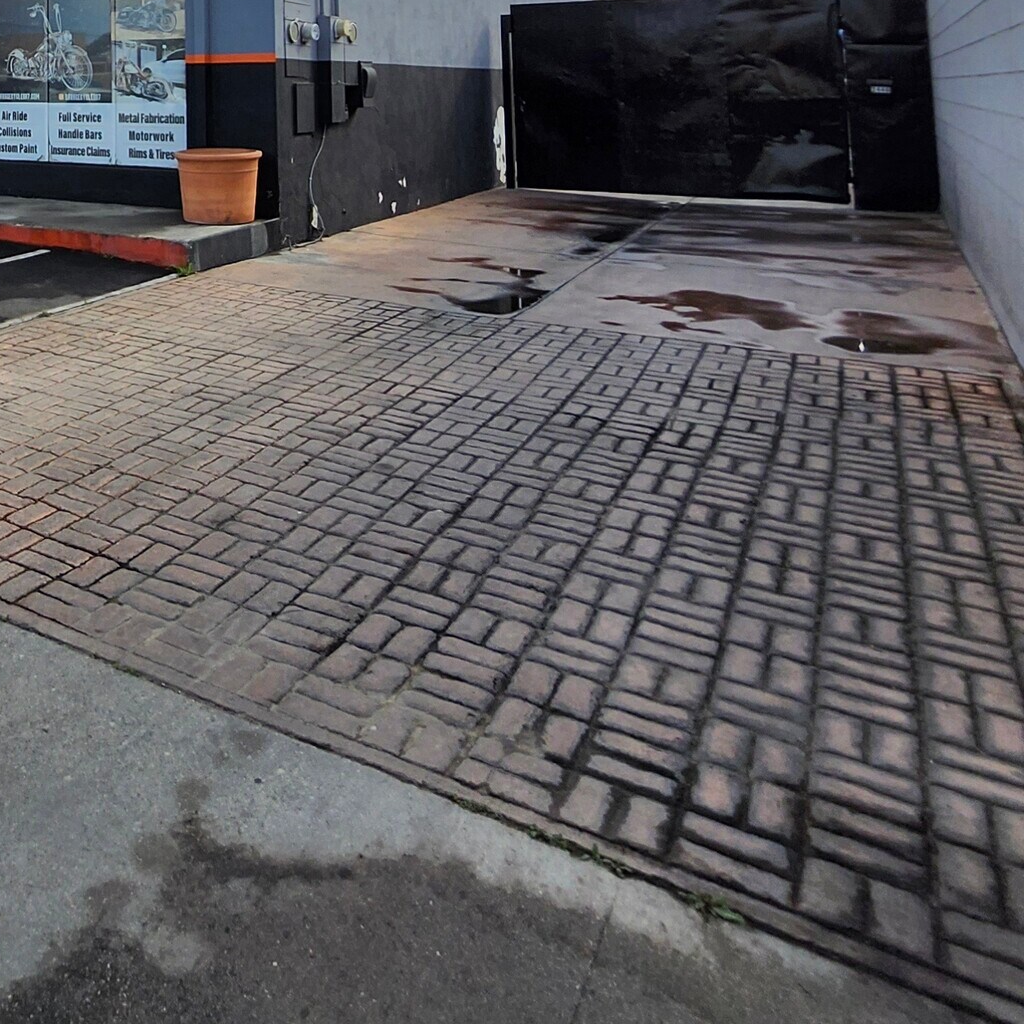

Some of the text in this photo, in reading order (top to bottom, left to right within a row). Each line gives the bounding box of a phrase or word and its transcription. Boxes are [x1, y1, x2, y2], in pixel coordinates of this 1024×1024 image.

[1, 110, 28, 121] Air Ride
[58, 112, 102, 123] Full Service
[118, 112, 185, 124] Metal Fabrication
[58, 128, 103, 140] Handle Bars
[128, 130, 175, 142] Motorwork
[19, 143, 38, 154] Paint
[50, 145, 111, 158] Insurance Claims
[128, 147, 176, 160] Rims & Tires
